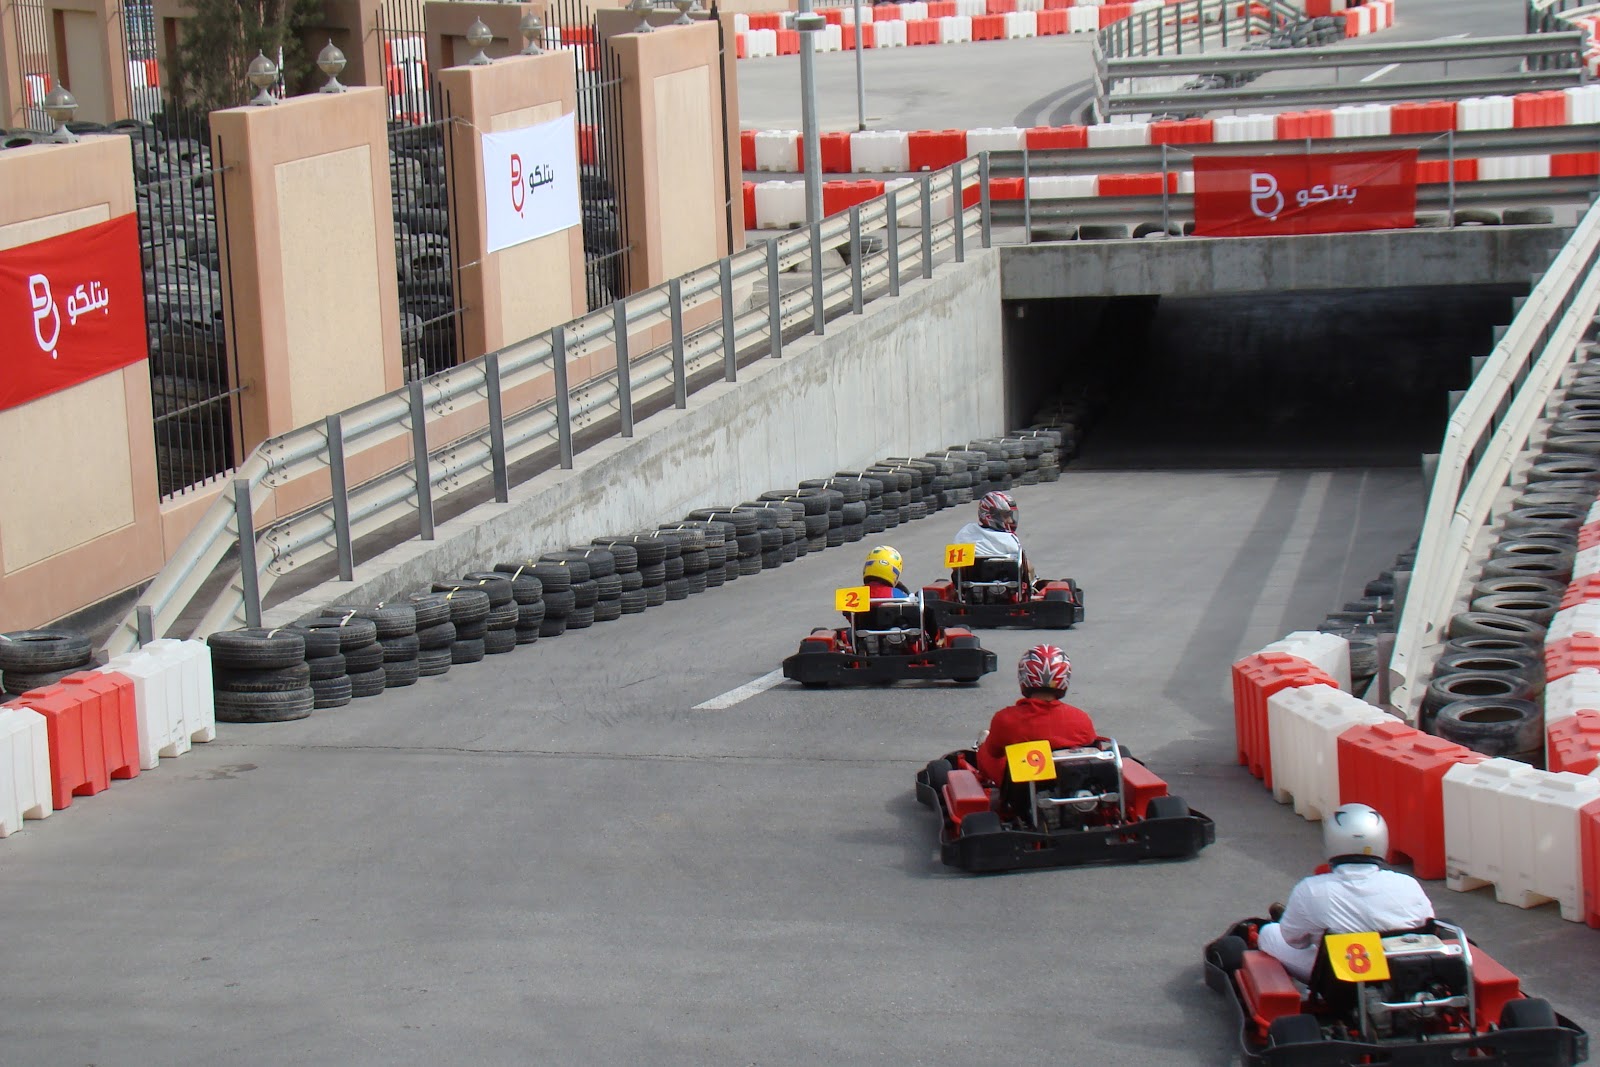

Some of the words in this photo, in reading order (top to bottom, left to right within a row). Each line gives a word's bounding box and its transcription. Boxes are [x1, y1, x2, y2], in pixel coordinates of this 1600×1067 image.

[528, 163, 554, 195] بتلكو
[1295, 184, 1357, 207] بتلكو
[67, 280, 109, 326] بتلكو
[948, 548, 964, 563] 11
[845, 592, 860, 608] 2
[1026, 749, 1047, 776] 9
[1346, 943, 1371, 975] 8
